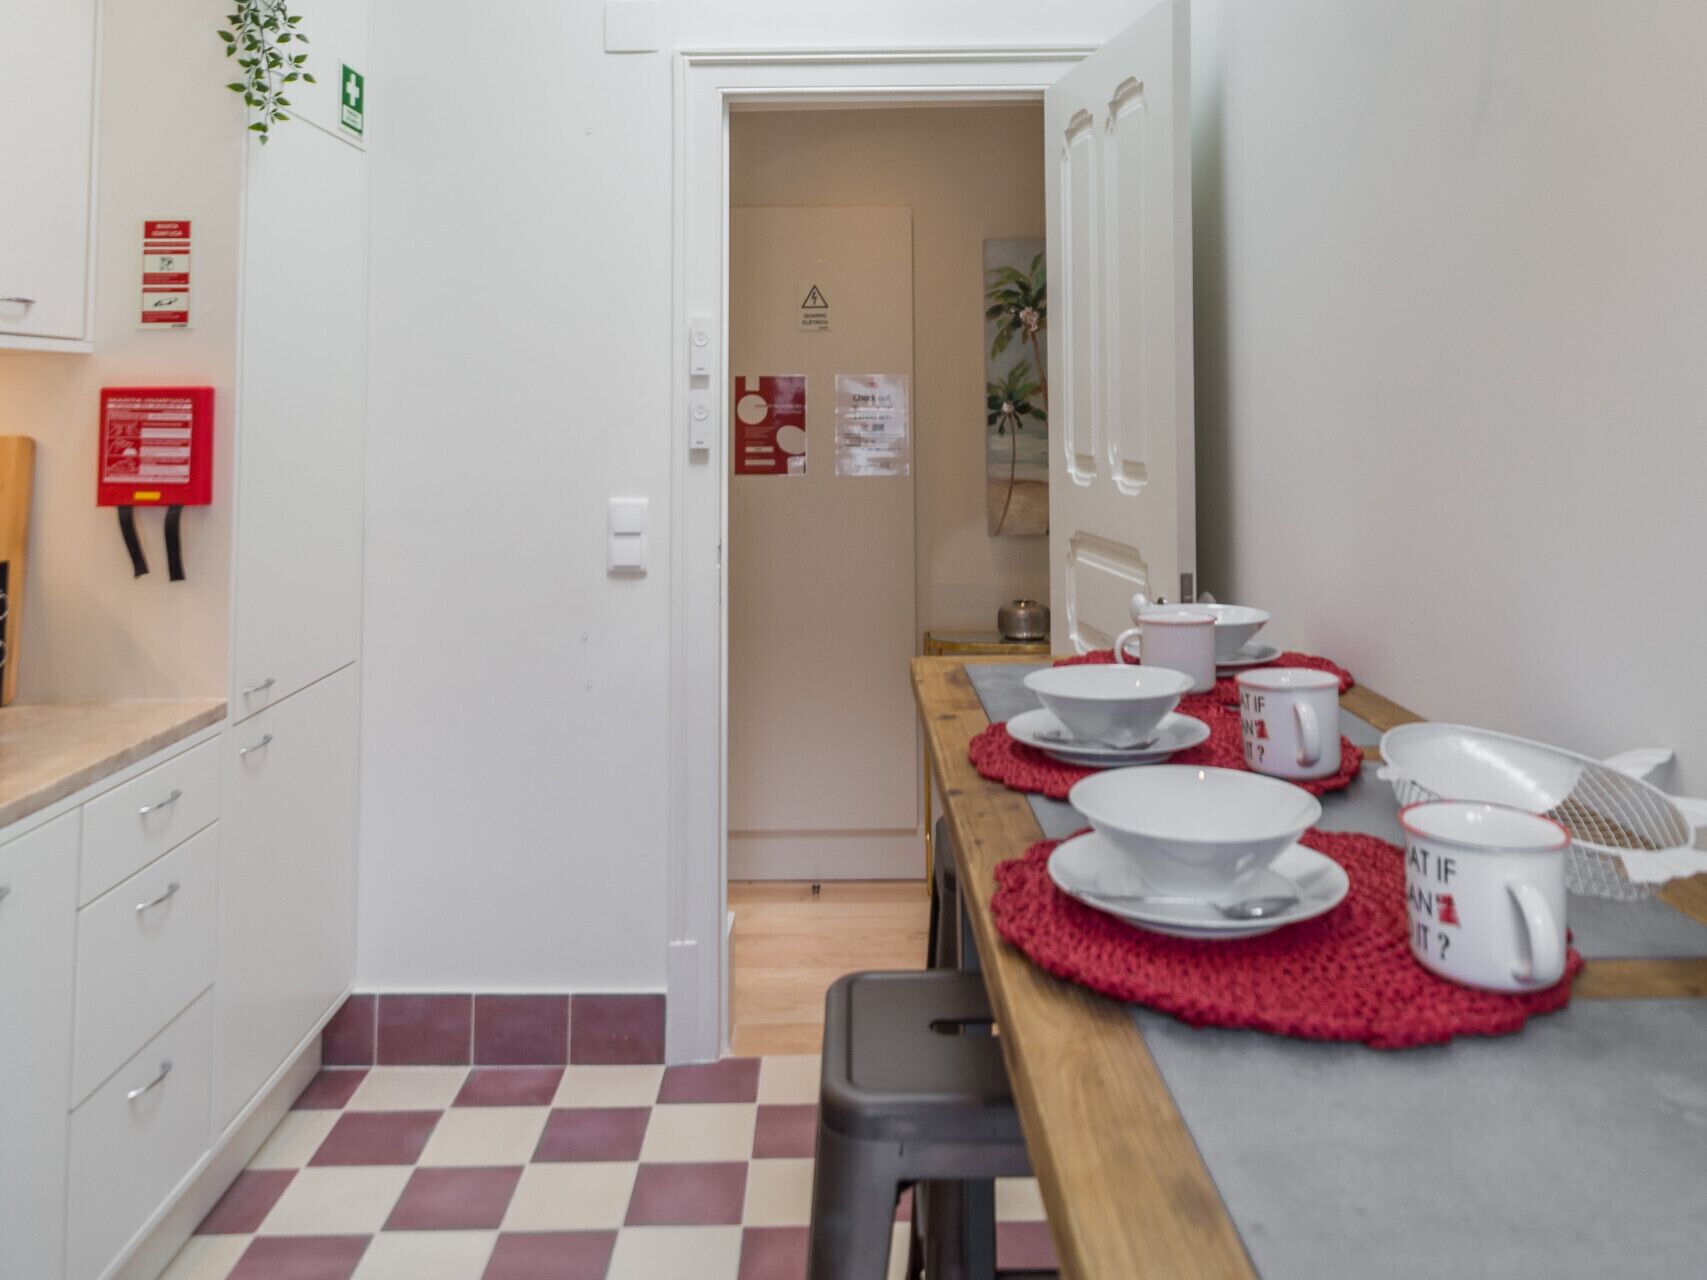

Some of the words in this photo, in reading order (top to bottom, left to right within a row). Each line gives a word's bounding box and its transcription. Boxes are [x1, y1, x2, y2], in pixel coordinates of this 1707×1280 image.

[1254, 695, 1266, 713] IF
[1408, 844, 1431, 877] AT
[1436, 855, 1458, 885] IF
[1416, 921, 1431, 953] IT
